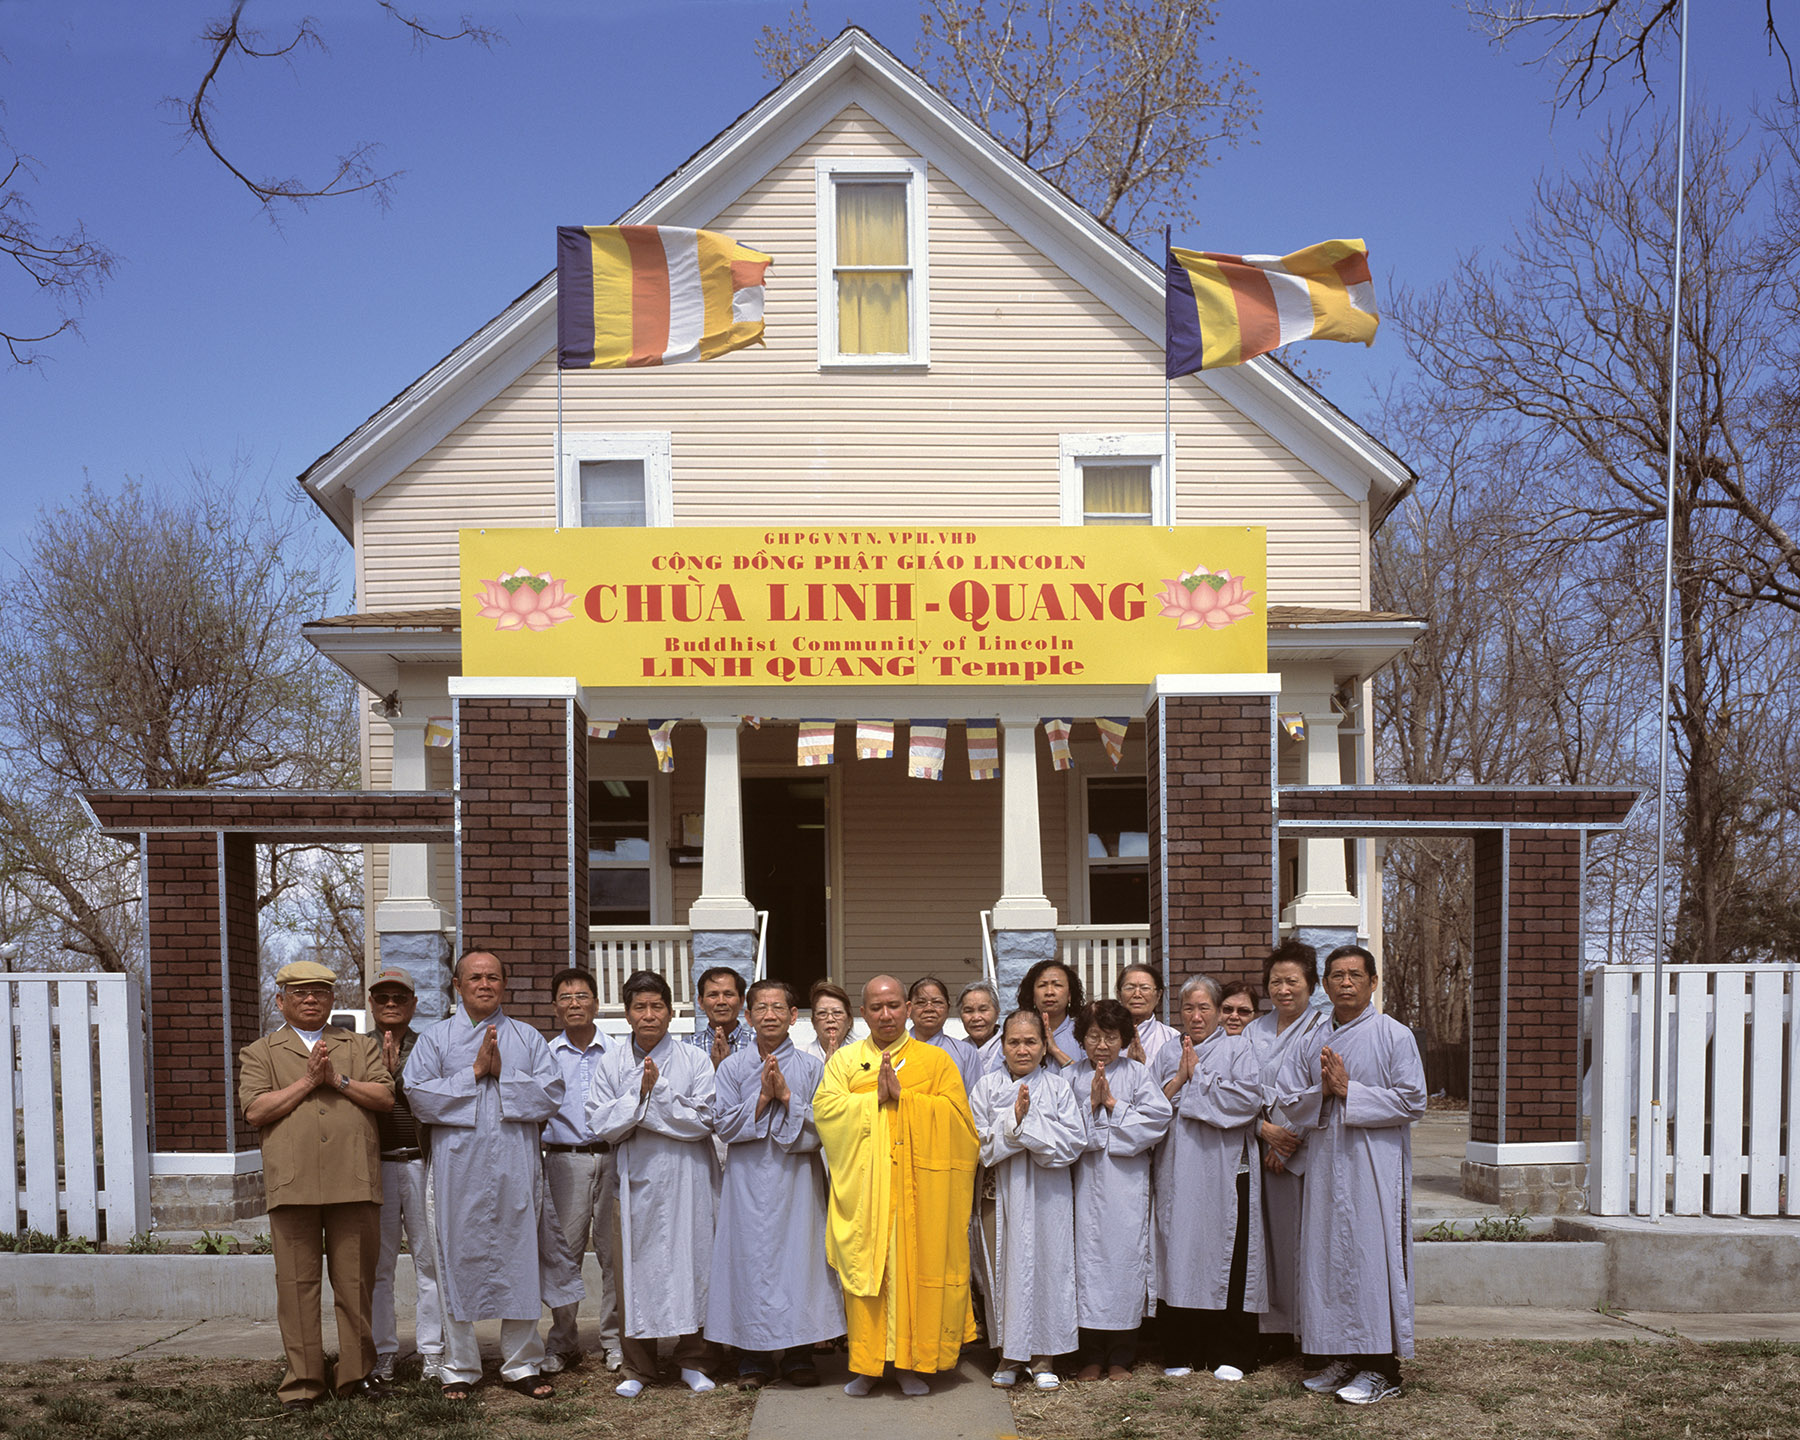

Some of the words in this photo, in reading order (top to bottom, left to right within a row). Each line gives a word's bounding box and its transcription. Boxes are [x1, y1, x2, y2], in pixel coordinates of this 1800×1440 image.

[651, 552, 722, 574] CỘNG
[733, 549, 804, 570] ĐỒNG
[815, 551, 888, 573] PHẬT
[897, 551, 965, 570] GIÁO
[973, 555, 1086, 570] LINCOLN
[584, 575, 745, 623] CHÙA
[664, 637, 778, 652] Buddhist
[792, 636, 932, 655] Community
[943, 636, 967, 651] of
[978, 635, 1074, 651] Lincoln
[640, 657, 754, 678] LINH
[765, 656, 917, 683] QUANG
[932, 655, 1086, 681] Temple
